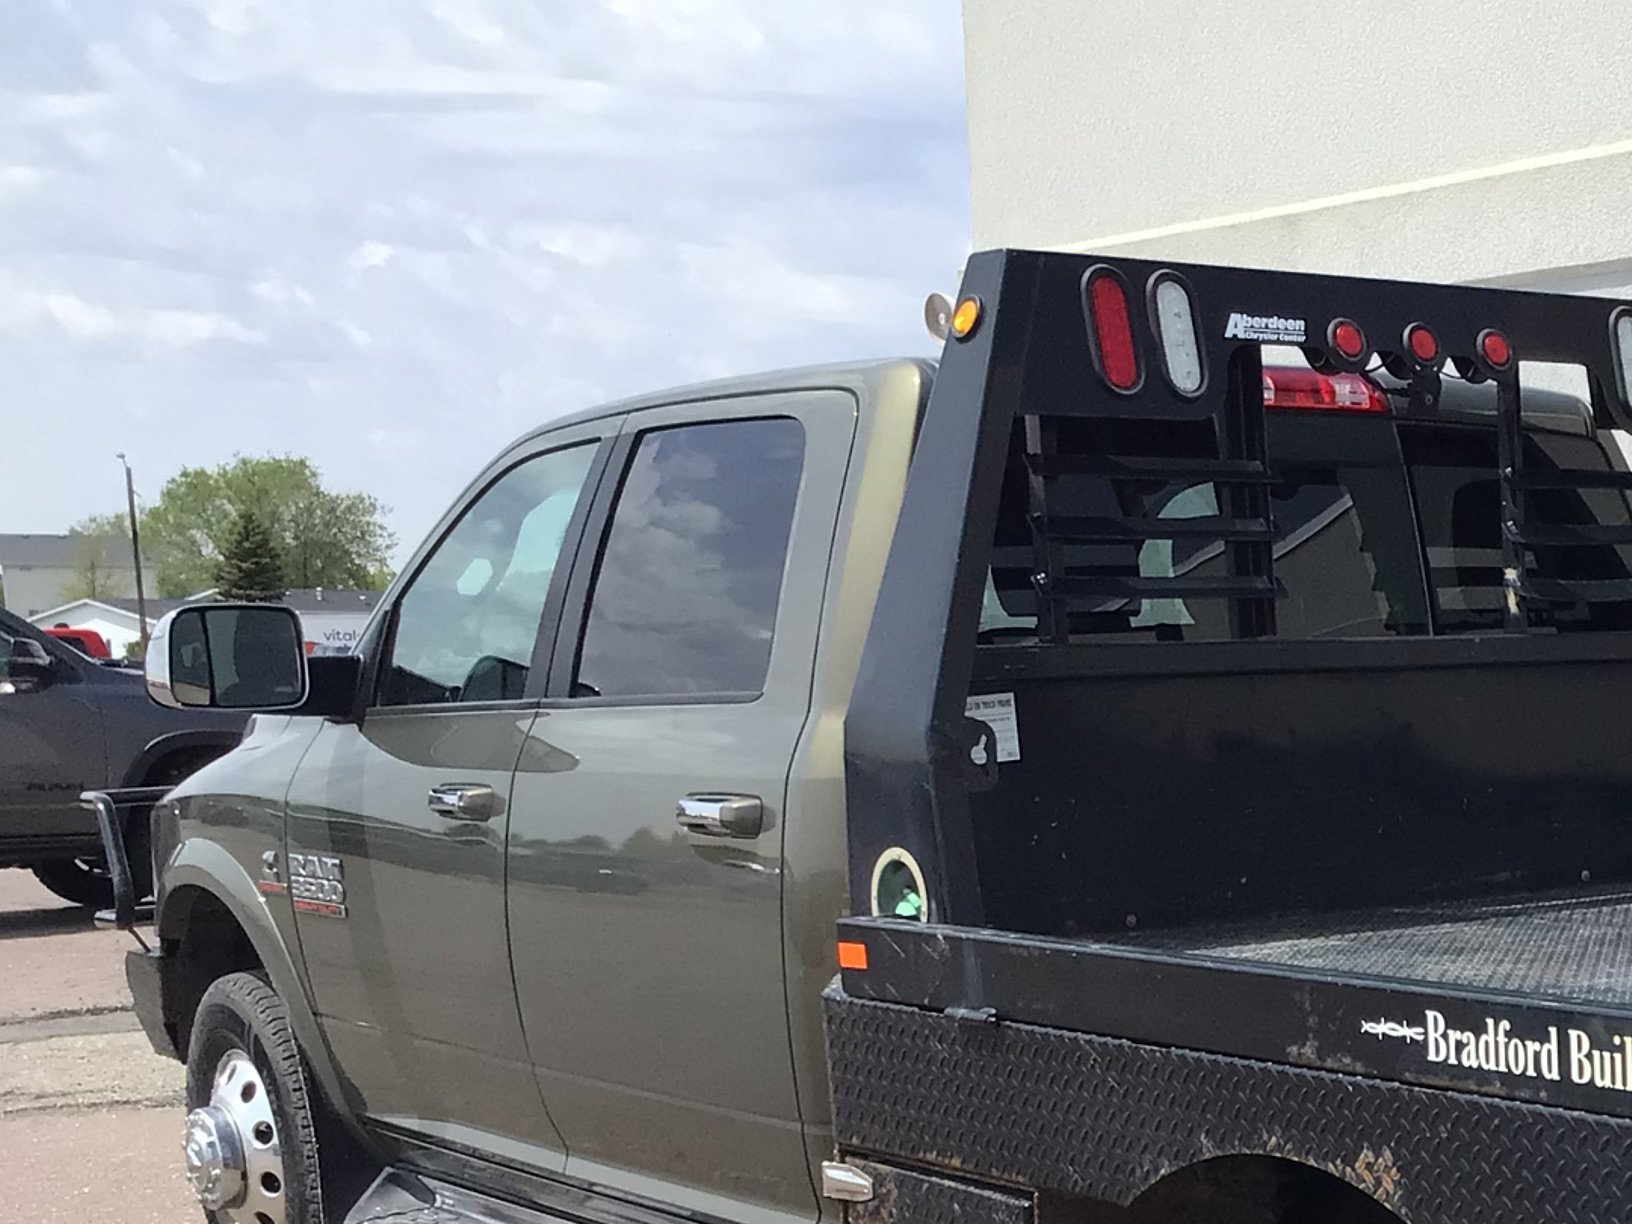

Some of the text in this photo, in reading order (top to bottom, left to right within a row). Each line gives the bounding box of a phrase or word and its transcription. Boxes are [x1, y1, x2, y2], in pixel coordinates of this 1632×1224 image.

[1224, 313, 1306, 339] Aberdeen
[323, 628, 360, 641] vital
[1425, 1009, 1561, 1081] Bradford
